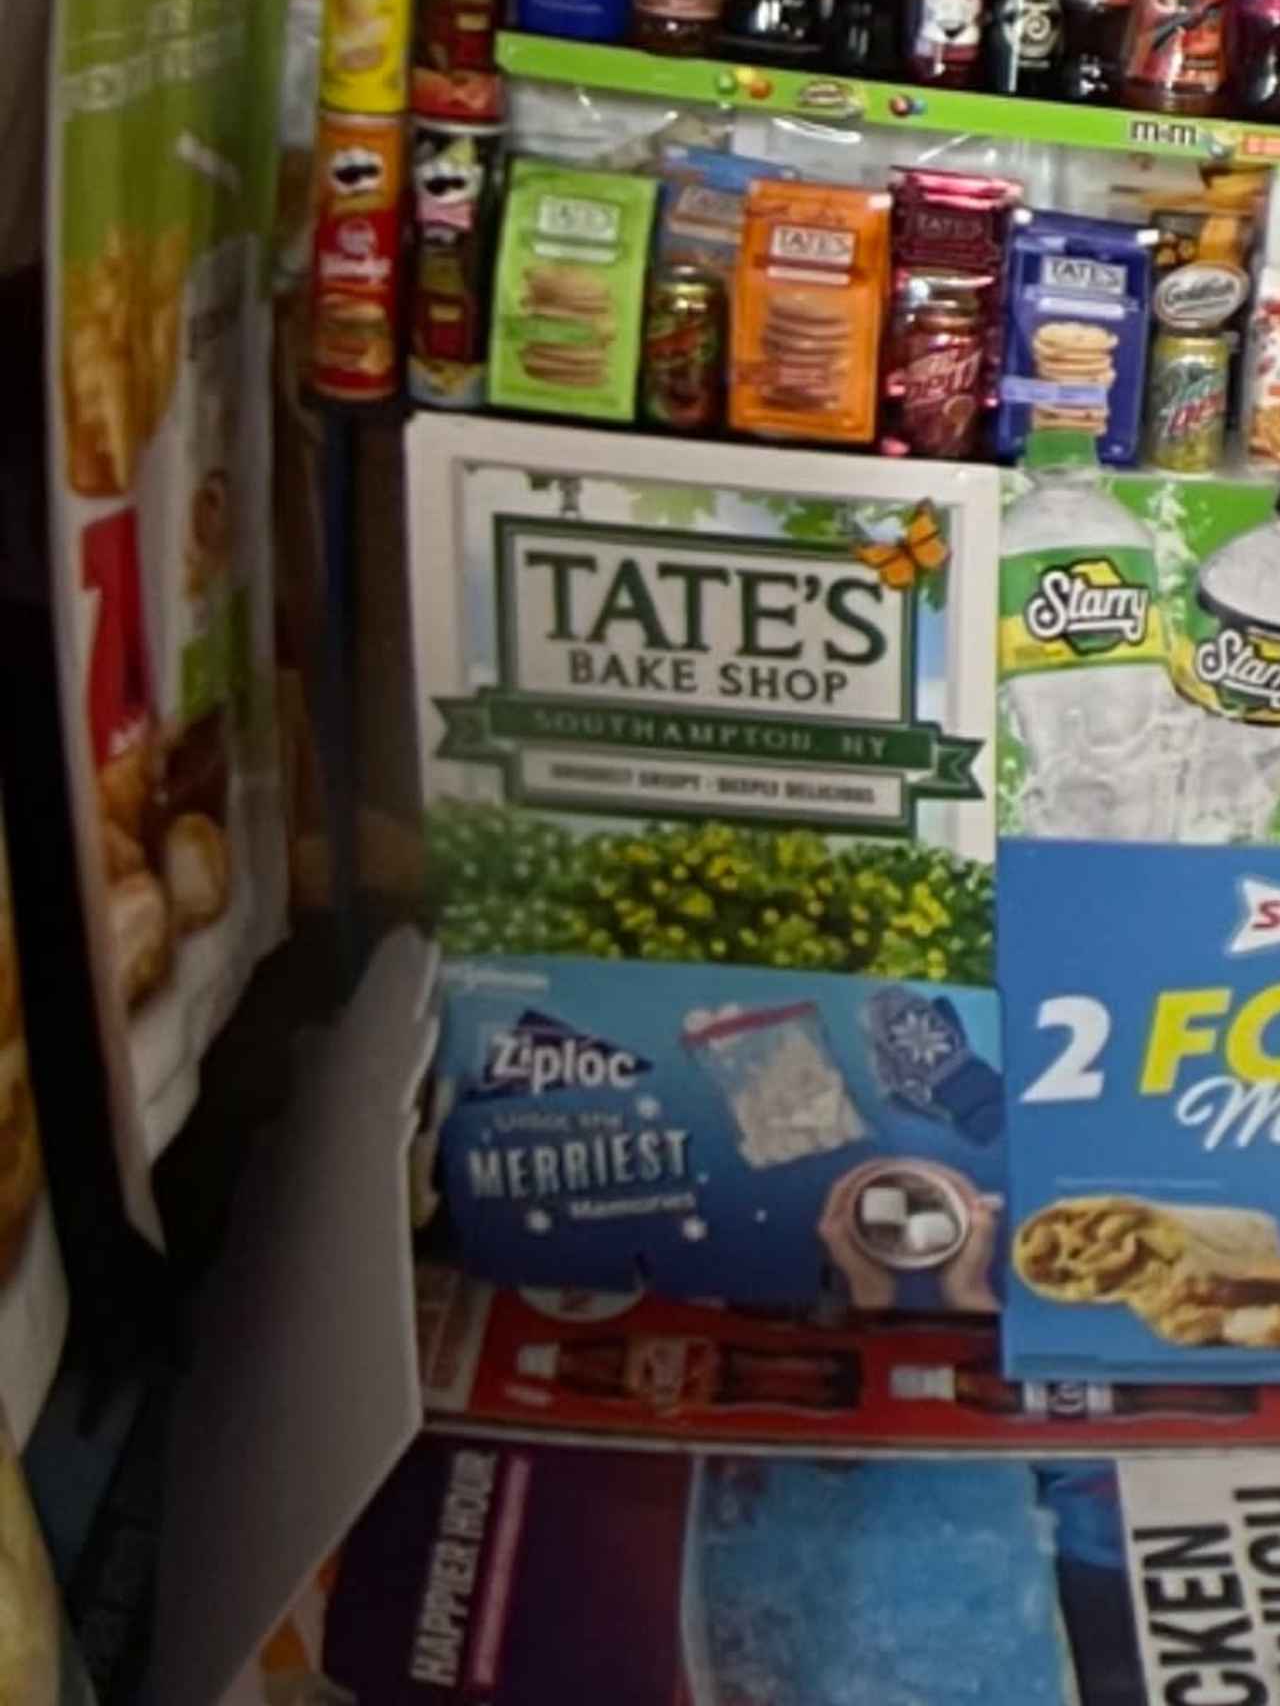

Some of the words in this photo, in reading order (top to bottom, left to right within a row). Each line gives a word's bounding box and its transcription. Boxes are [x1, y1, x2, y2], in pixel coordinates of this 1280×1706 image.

[524, 551, 890, 667] TATE'S
[1028, 567, 1149, 642] Starry
[568, 649, 698, 693] BAKE
[719, 662, 849, 706] SHOP
[841, 733, 889, 760] NY
[492, 1037, 638, 1097] Ziploc
[1020, 995, 1112, 1104] 2
[468, 1128, 693, 1199] MERRIEST
[411, 1546, 482, 1687] HAPPIER
[449, 1451, 500, 1548] HOUR
